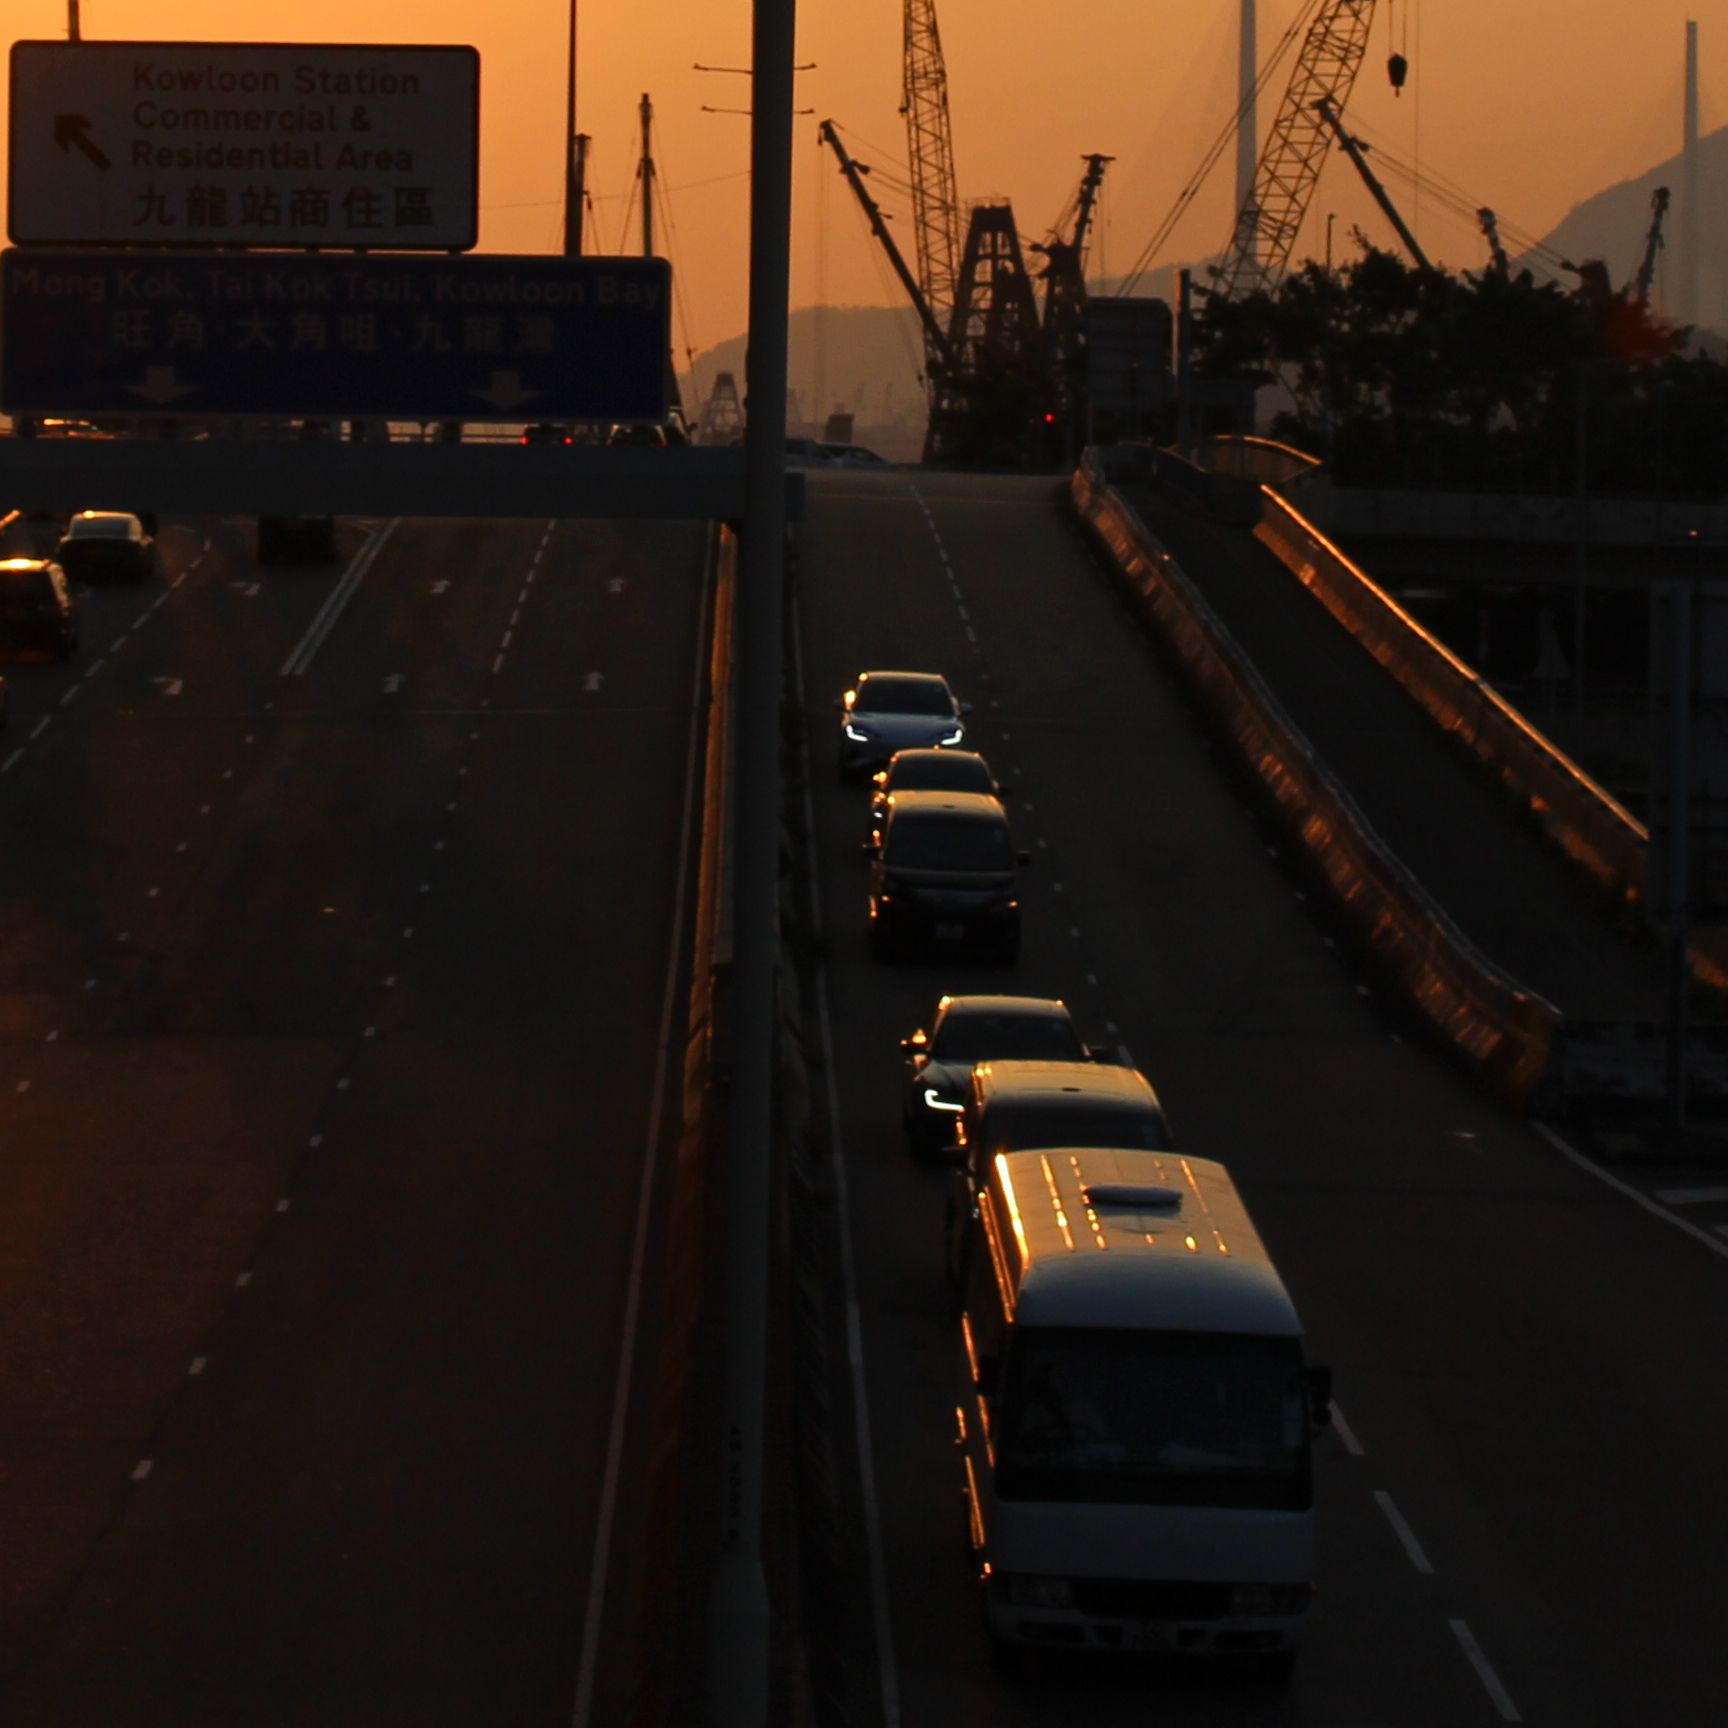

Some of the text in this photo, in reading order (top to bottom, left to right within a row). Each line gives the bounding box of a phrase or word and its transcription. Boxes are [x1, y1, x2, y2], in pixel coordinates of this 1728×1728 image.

[133, 63, 421, 94] Kowloon Station
[133, 101, 372, 132] Commercial &
[131, 140, 414, 172] Residential Area
[132, 183, 434, 229] 九龍站商住區
[10, 268, 106, 303] Mong
[204, 269, 253, 298] Tai
[264, 271, 331, 300] Kok
[434, 273, 583, 304] Kowloon
[596, 274, 664, 310] Bay
